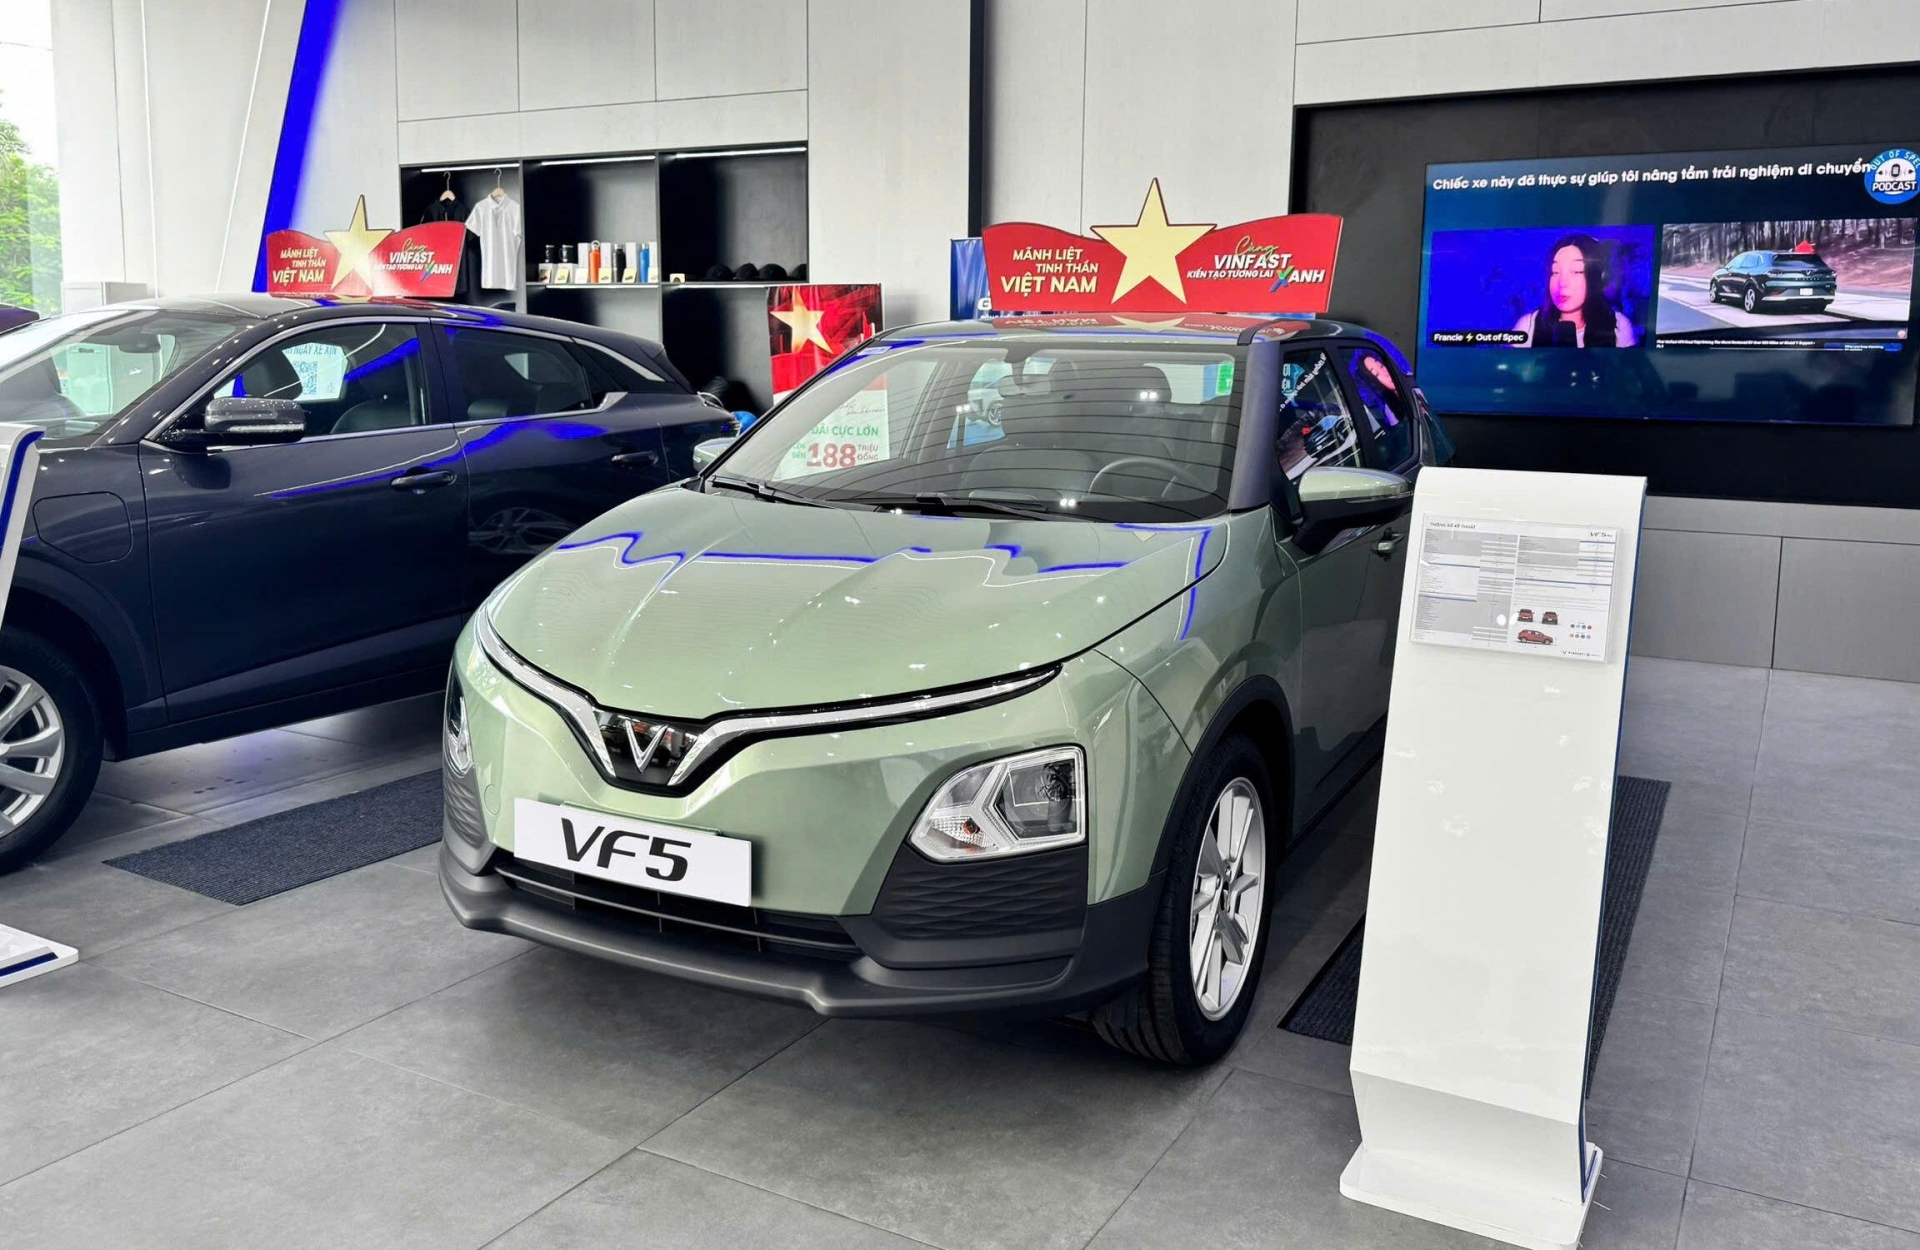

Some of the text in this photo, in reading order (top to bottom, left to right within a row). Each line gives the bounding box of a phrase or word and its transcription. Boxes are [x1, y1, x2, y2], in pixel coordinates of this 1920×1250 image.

[1888, 150, 1901, 158] OF
[1432, 157, 1871, 190] Chiếc xe này đã thực sự giúp tôi nâng tầm trải nghiệm di chuyển
[1872, 181, 1917, 192] PODCAST
[389, 250, 435, 264] VINFAST
[1012, 245, 1084, 263] MÃNH LIỆT
[1213, 253, 1293, 270] VINFAST
[292, 259, 307, 268] TINH
[1035, 262, 1063, 273] TINH
[272, 266, 325, 288] VIỆT NAM
[1000, 271, 1098, 297] VIỆT NAM
[1186, 266, 1207, 279] KIẾN
[1207, 269, 1227, 280] TẠO
[1259, 269, 1275, 279] LAI
[1269, 265, 1326, 292] XANH
[1475, 333, 1492, 342] Out
[1492, 333, 1503, 342] of
[1502, 333, 1524, 344] Spec
[806, 442, 857, 468] 188
[561, 817, 692, 882] VF5
